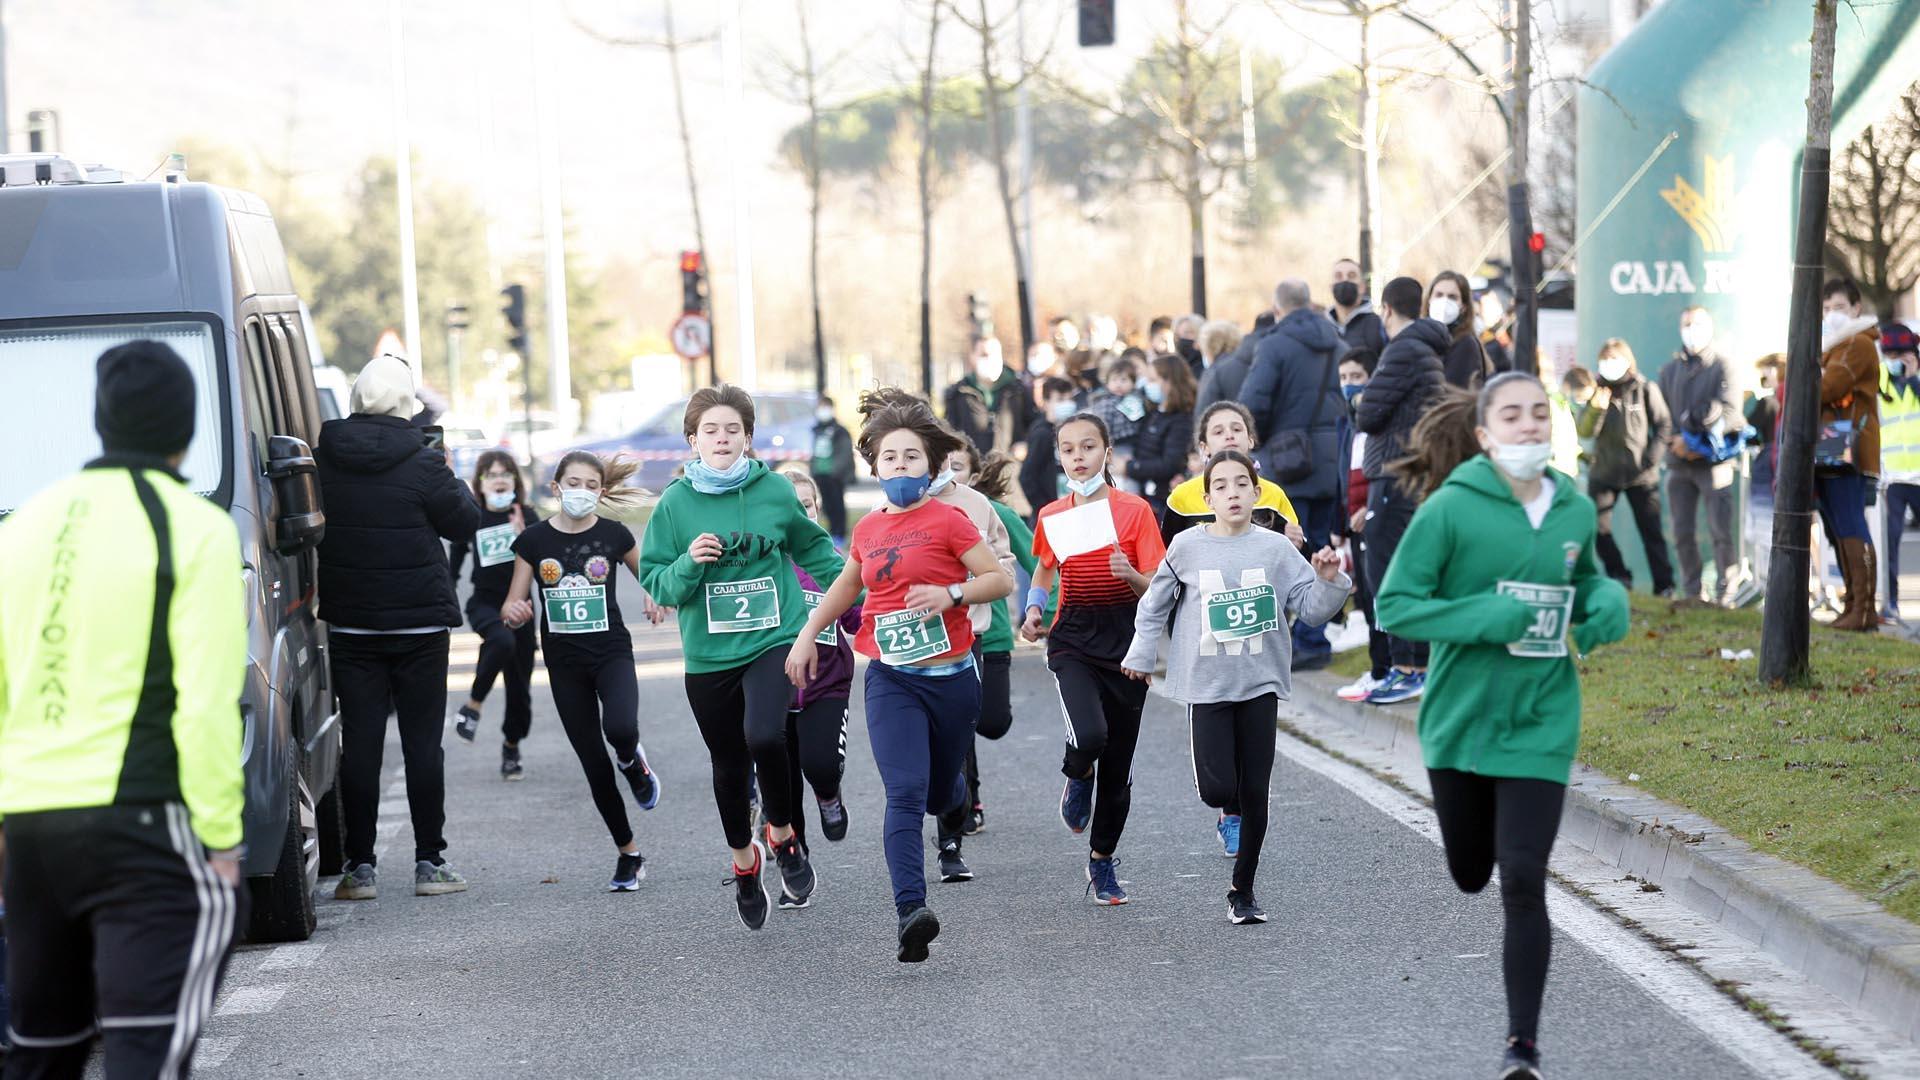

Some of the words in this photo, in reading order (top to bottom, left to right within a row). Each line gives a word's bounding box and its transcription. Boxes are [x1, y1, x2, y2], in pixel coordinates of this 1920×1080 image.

[1610, 261, 1696, 296] CAJA
[570, 588, 599, 598] RURAL
[713, 586, 735, 594] CAJA
[738, 582, 768, 593] RURAL
[1213, 594, 1235, 603] CAJA
[1237, 587, 1268, 600] RURAL
[561, 601, 588, 621] 16
[734, 597, 751, 619] 2
[1226, 602, 1257, 627] 95
[885, 622, 930, 651] 231
